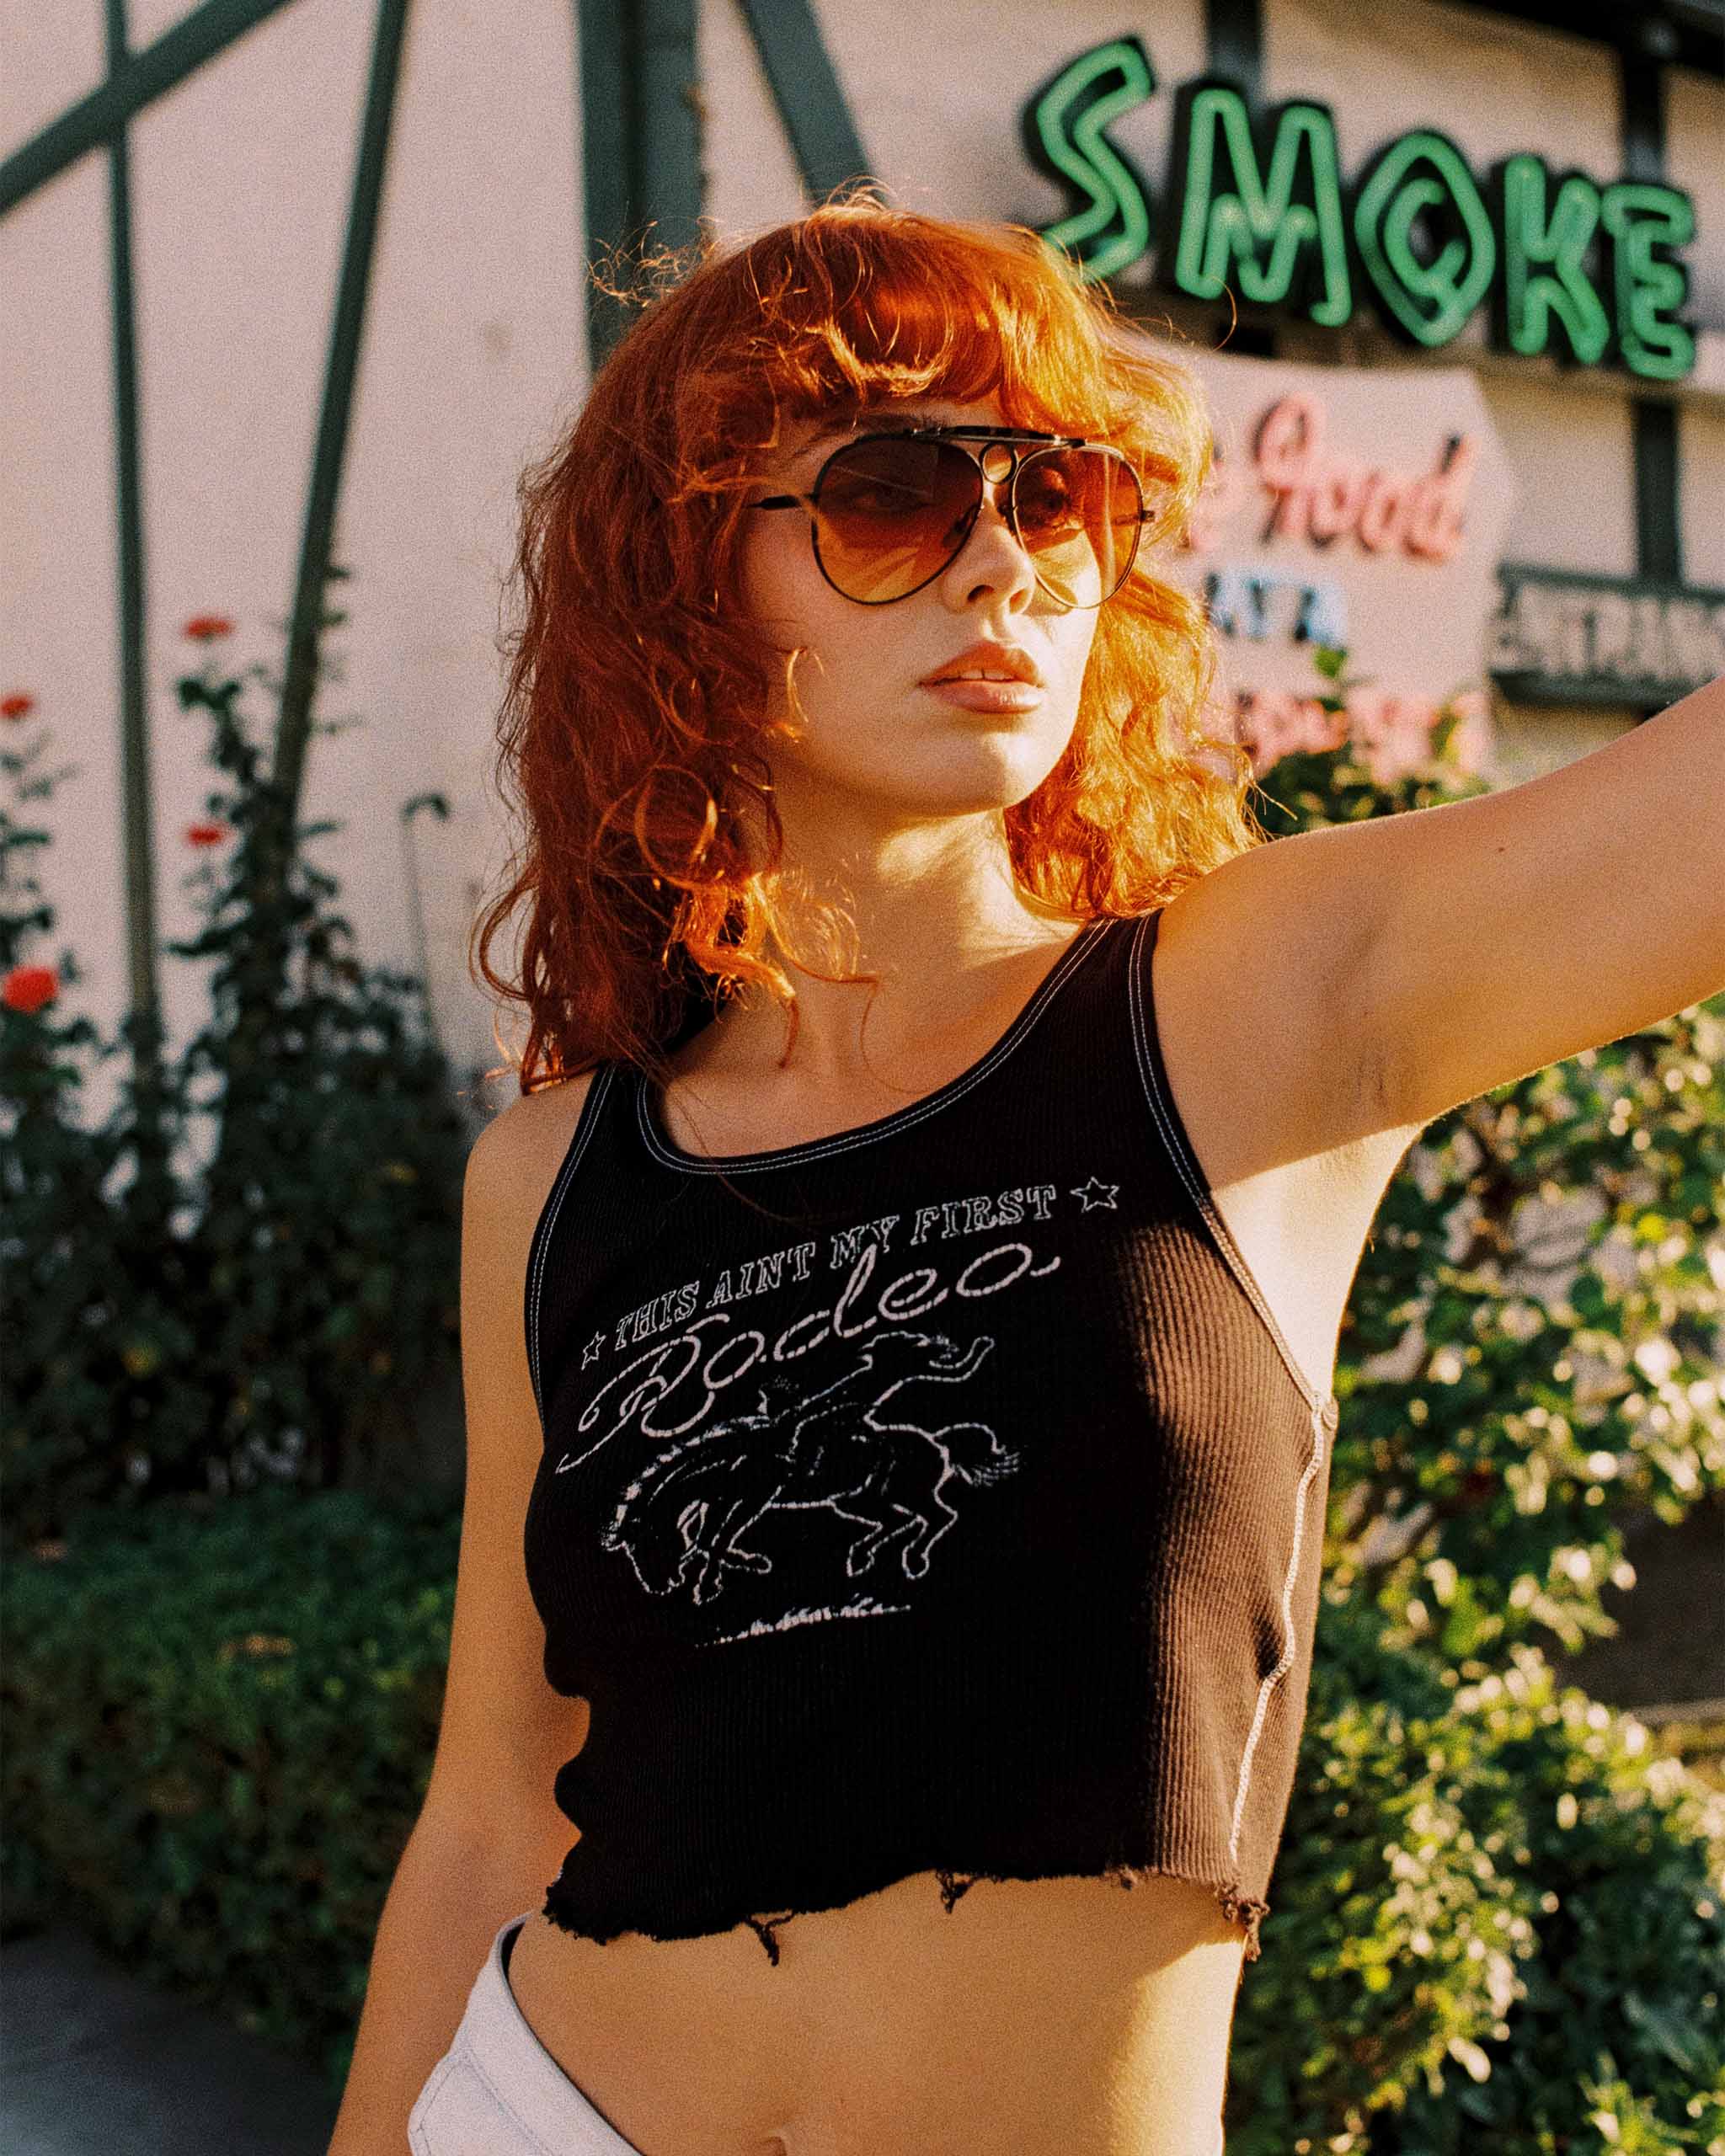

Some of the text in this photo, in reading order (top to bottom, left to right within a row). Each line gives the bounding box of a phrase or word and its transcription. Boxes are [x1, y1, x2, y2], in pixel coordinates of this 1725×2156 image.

[1029, 35, 1696, 381] SMOKE
[555, 1242, 1061, 1475] Rodeo
[614, 1280, 700, 1352] THIS
[830, 1214, 900, 1269] MY
[910, 1184, 1056, 1246] FIRST
